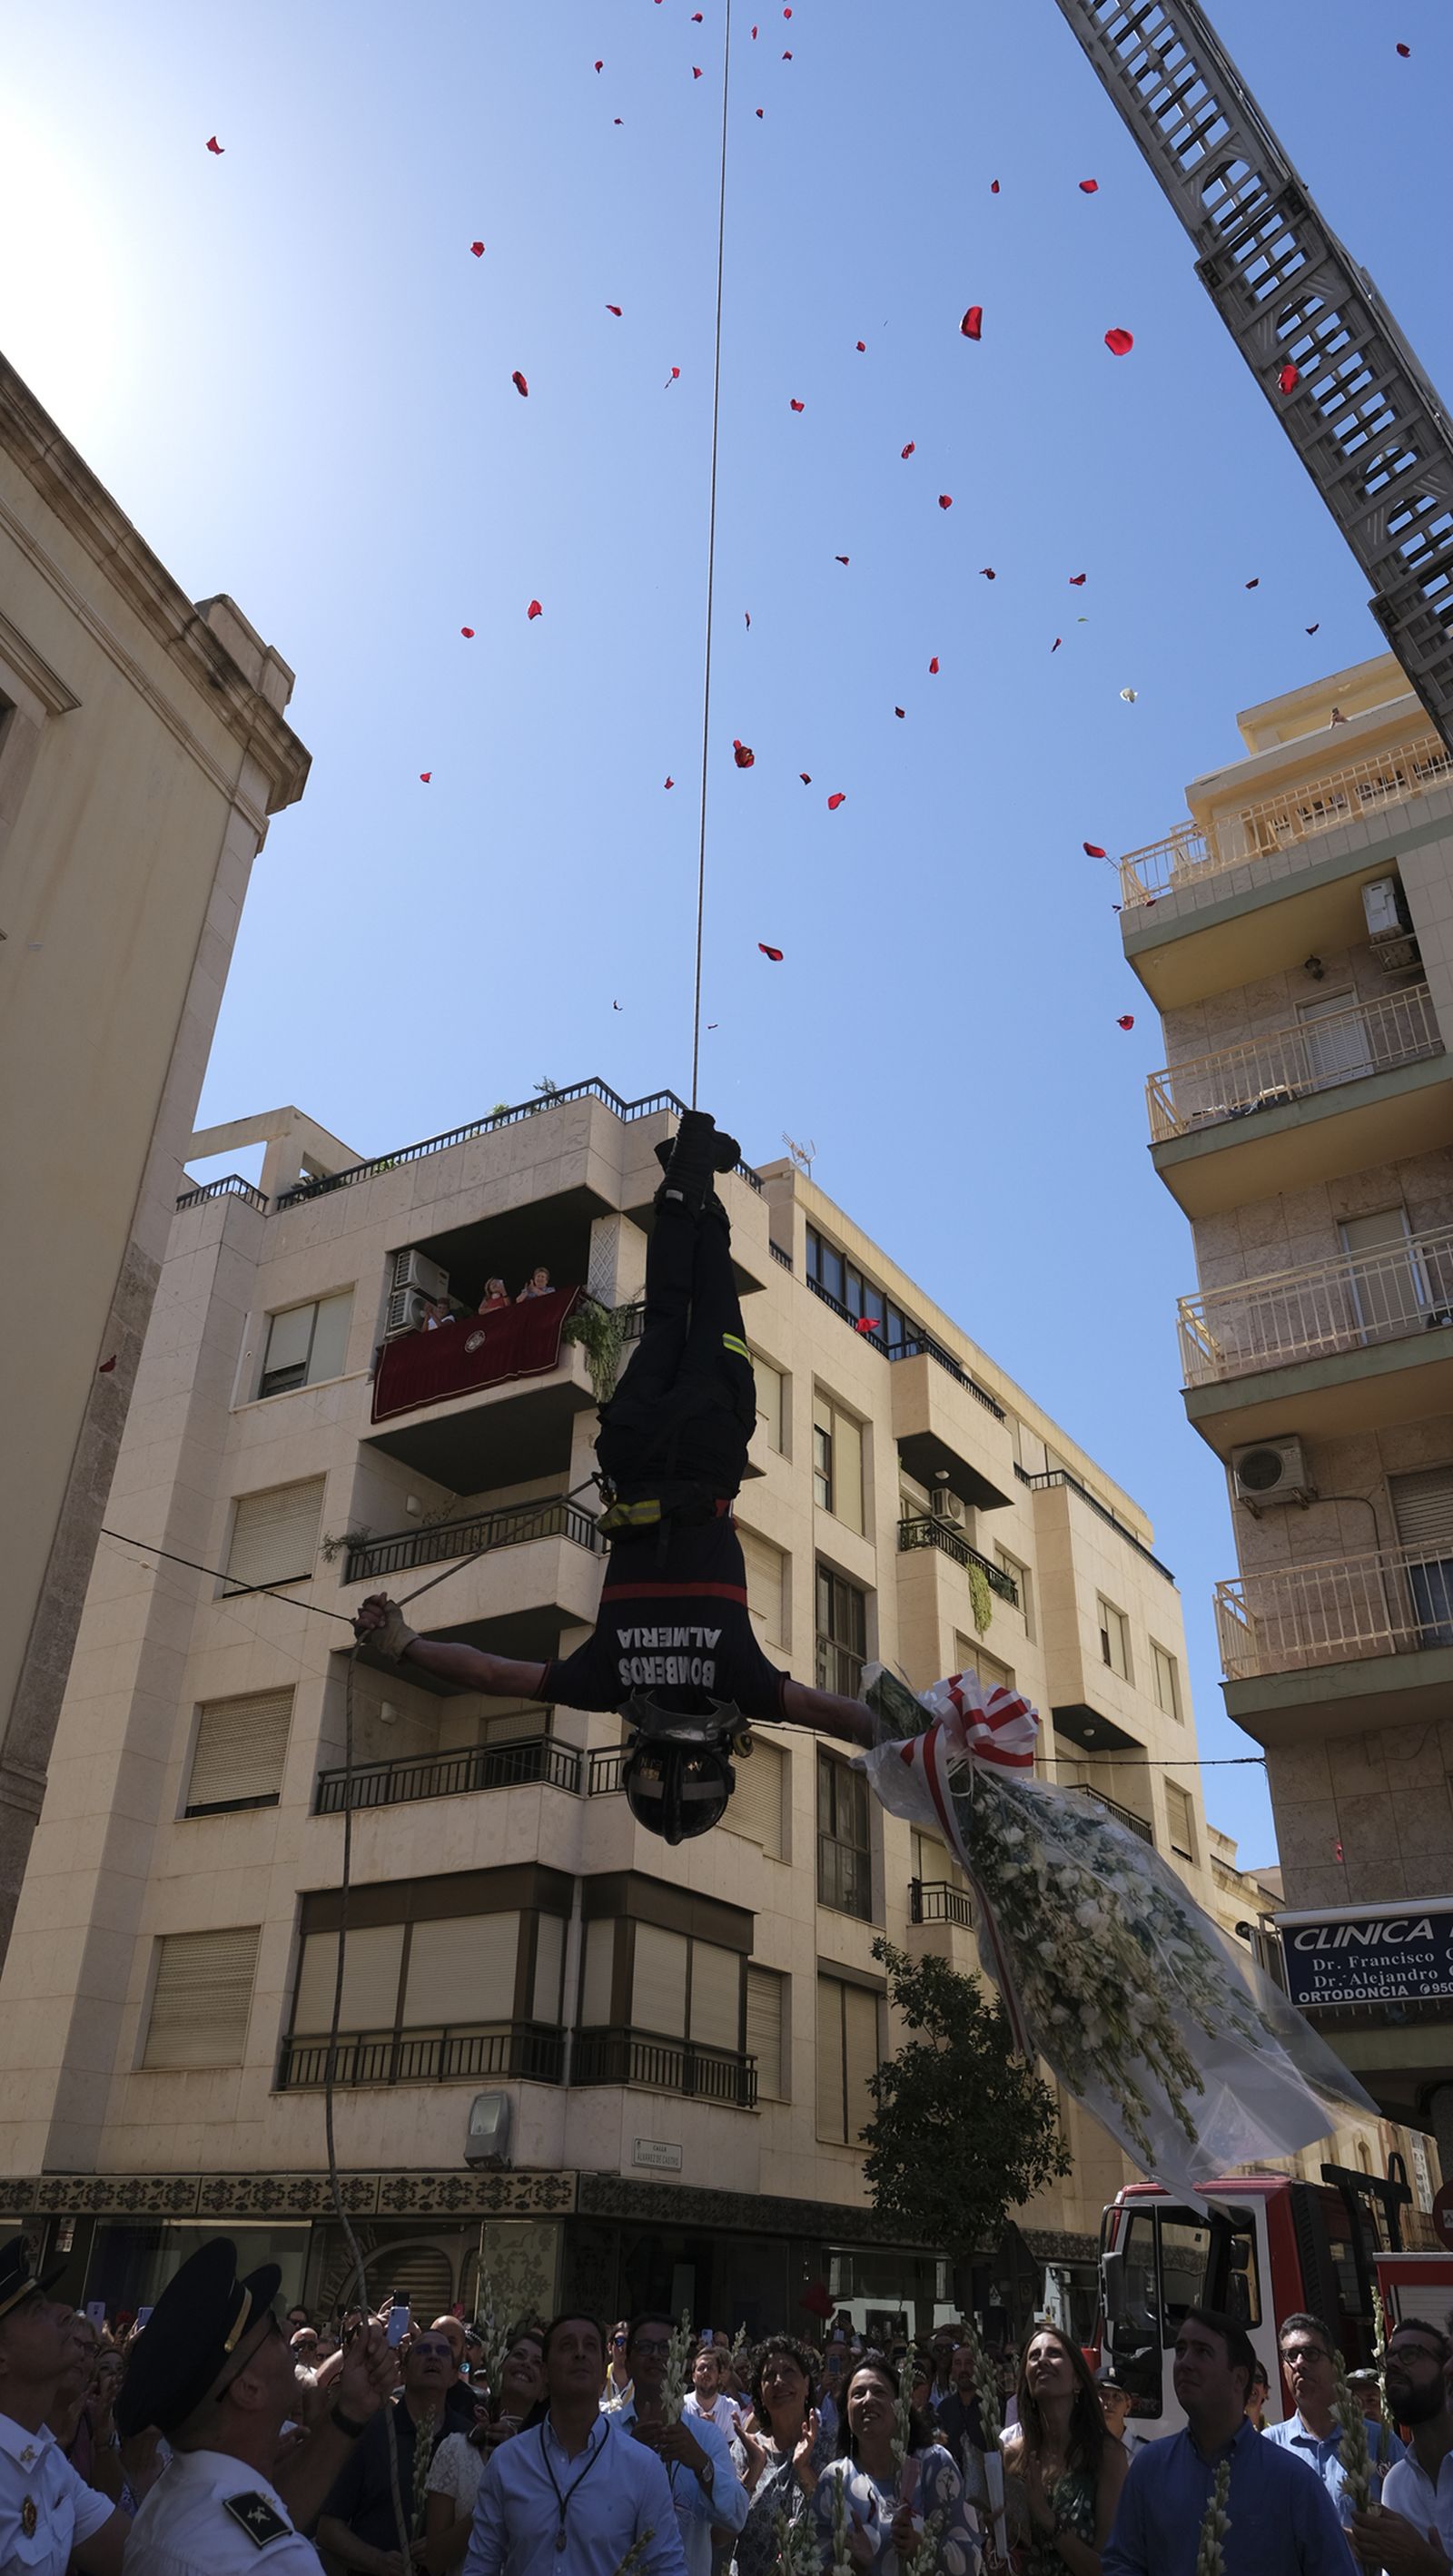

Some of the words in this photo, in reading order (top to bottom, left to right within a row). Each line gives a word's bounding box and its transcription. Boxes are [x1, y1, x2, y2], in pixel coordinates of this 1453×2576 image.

[617, 1626, 722, 1649] ALMERIA
[618, 1656, 716, 1689] BOMBEROS
[1294, 1918, 1434, 1951] CLINICA
[1312, 1959, 1342, 1971] Dr.
[1349, 1951, 1435, 1969] Francisco
[1314, 1975, 1343, 1989] Dr.
[1349, 1968, 1438, 1987] Alejandro
[1299, 1985, 1409, 2003] ORTODONCIA
